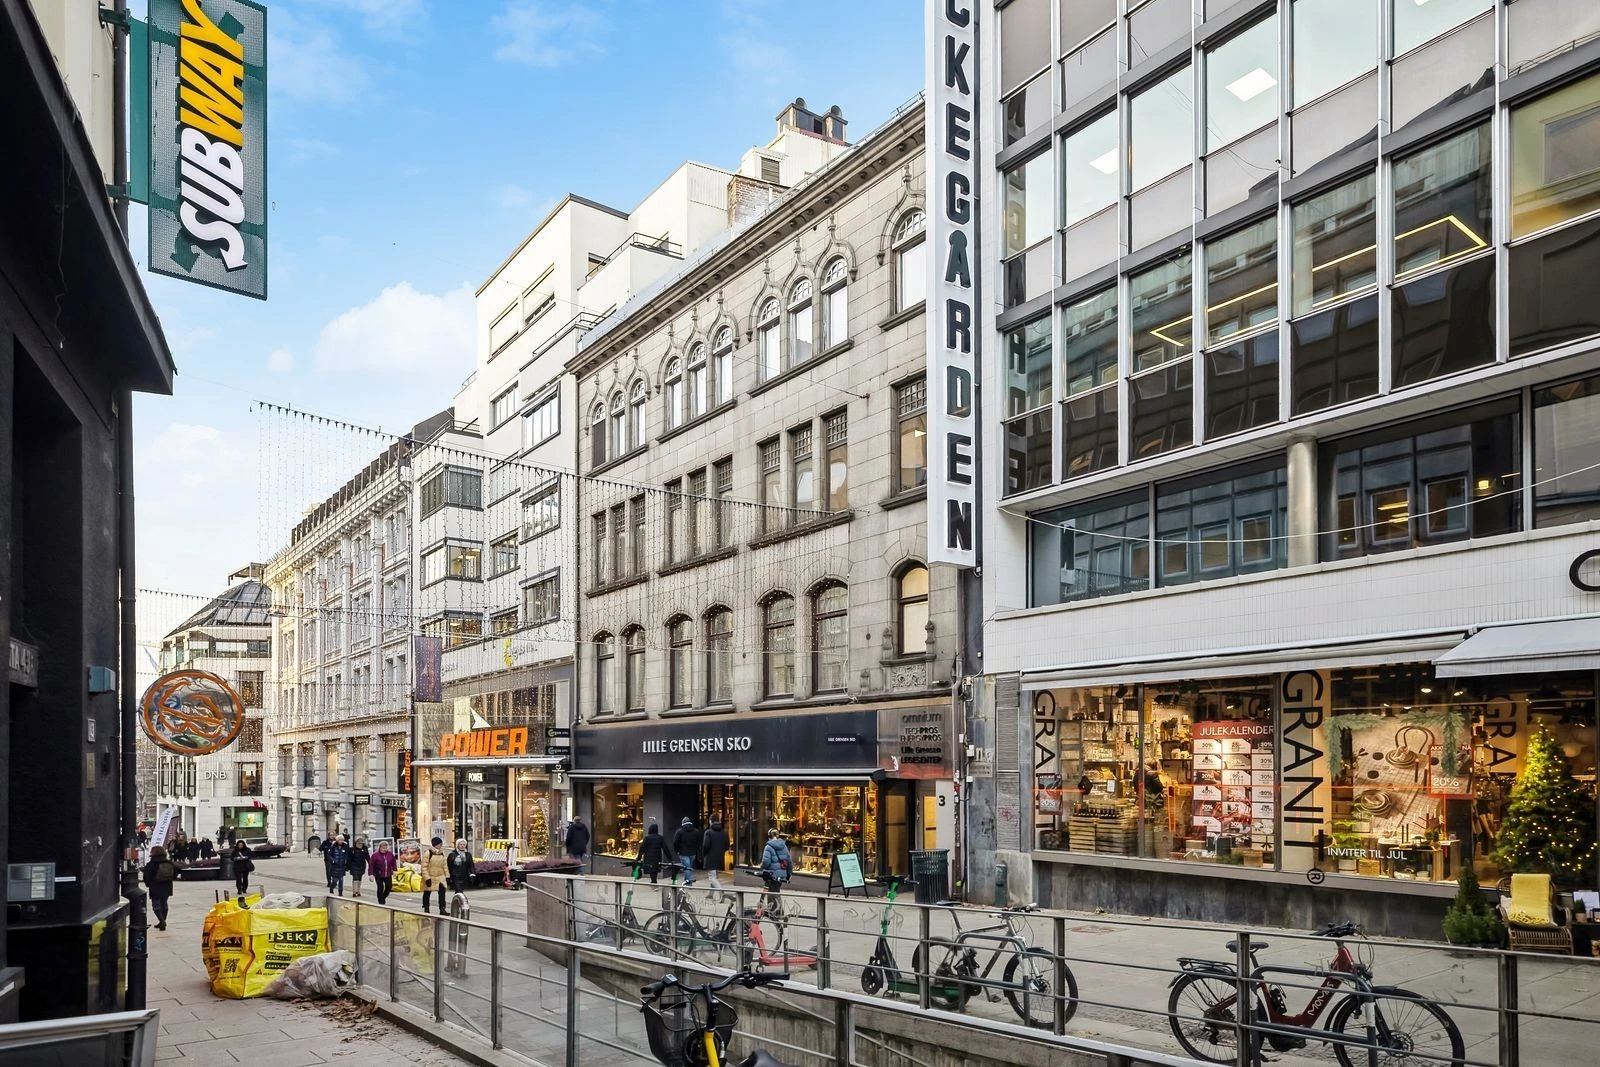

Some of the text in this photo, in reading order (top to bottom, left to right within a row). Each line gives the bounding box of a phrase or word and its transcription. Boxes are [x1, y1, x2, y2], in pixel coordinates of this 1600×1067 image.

[179, 0, 248, 271] SUBWAY
[1199, 725, 1274, 736] JULEKALENDER
[439, 728, 528, 758] POWER
[643, 736, 752, 753] LILLE GRENSEN SKO
[404, 751, 412, 792] POWER
[1283, 669, 1324, 861] GRANIT
[204, 770, 227, 781] DNB
[468, 772, 483, 782] POWER
[557, 773, 563, 784] 5
[1432, 777, 1459, 787] 20%
[938, 795, 946, 807] 3
[1327, 847, 1408, 860] INVITER TIL JUL
[1307, 981, 1335, 1016] MOMS
